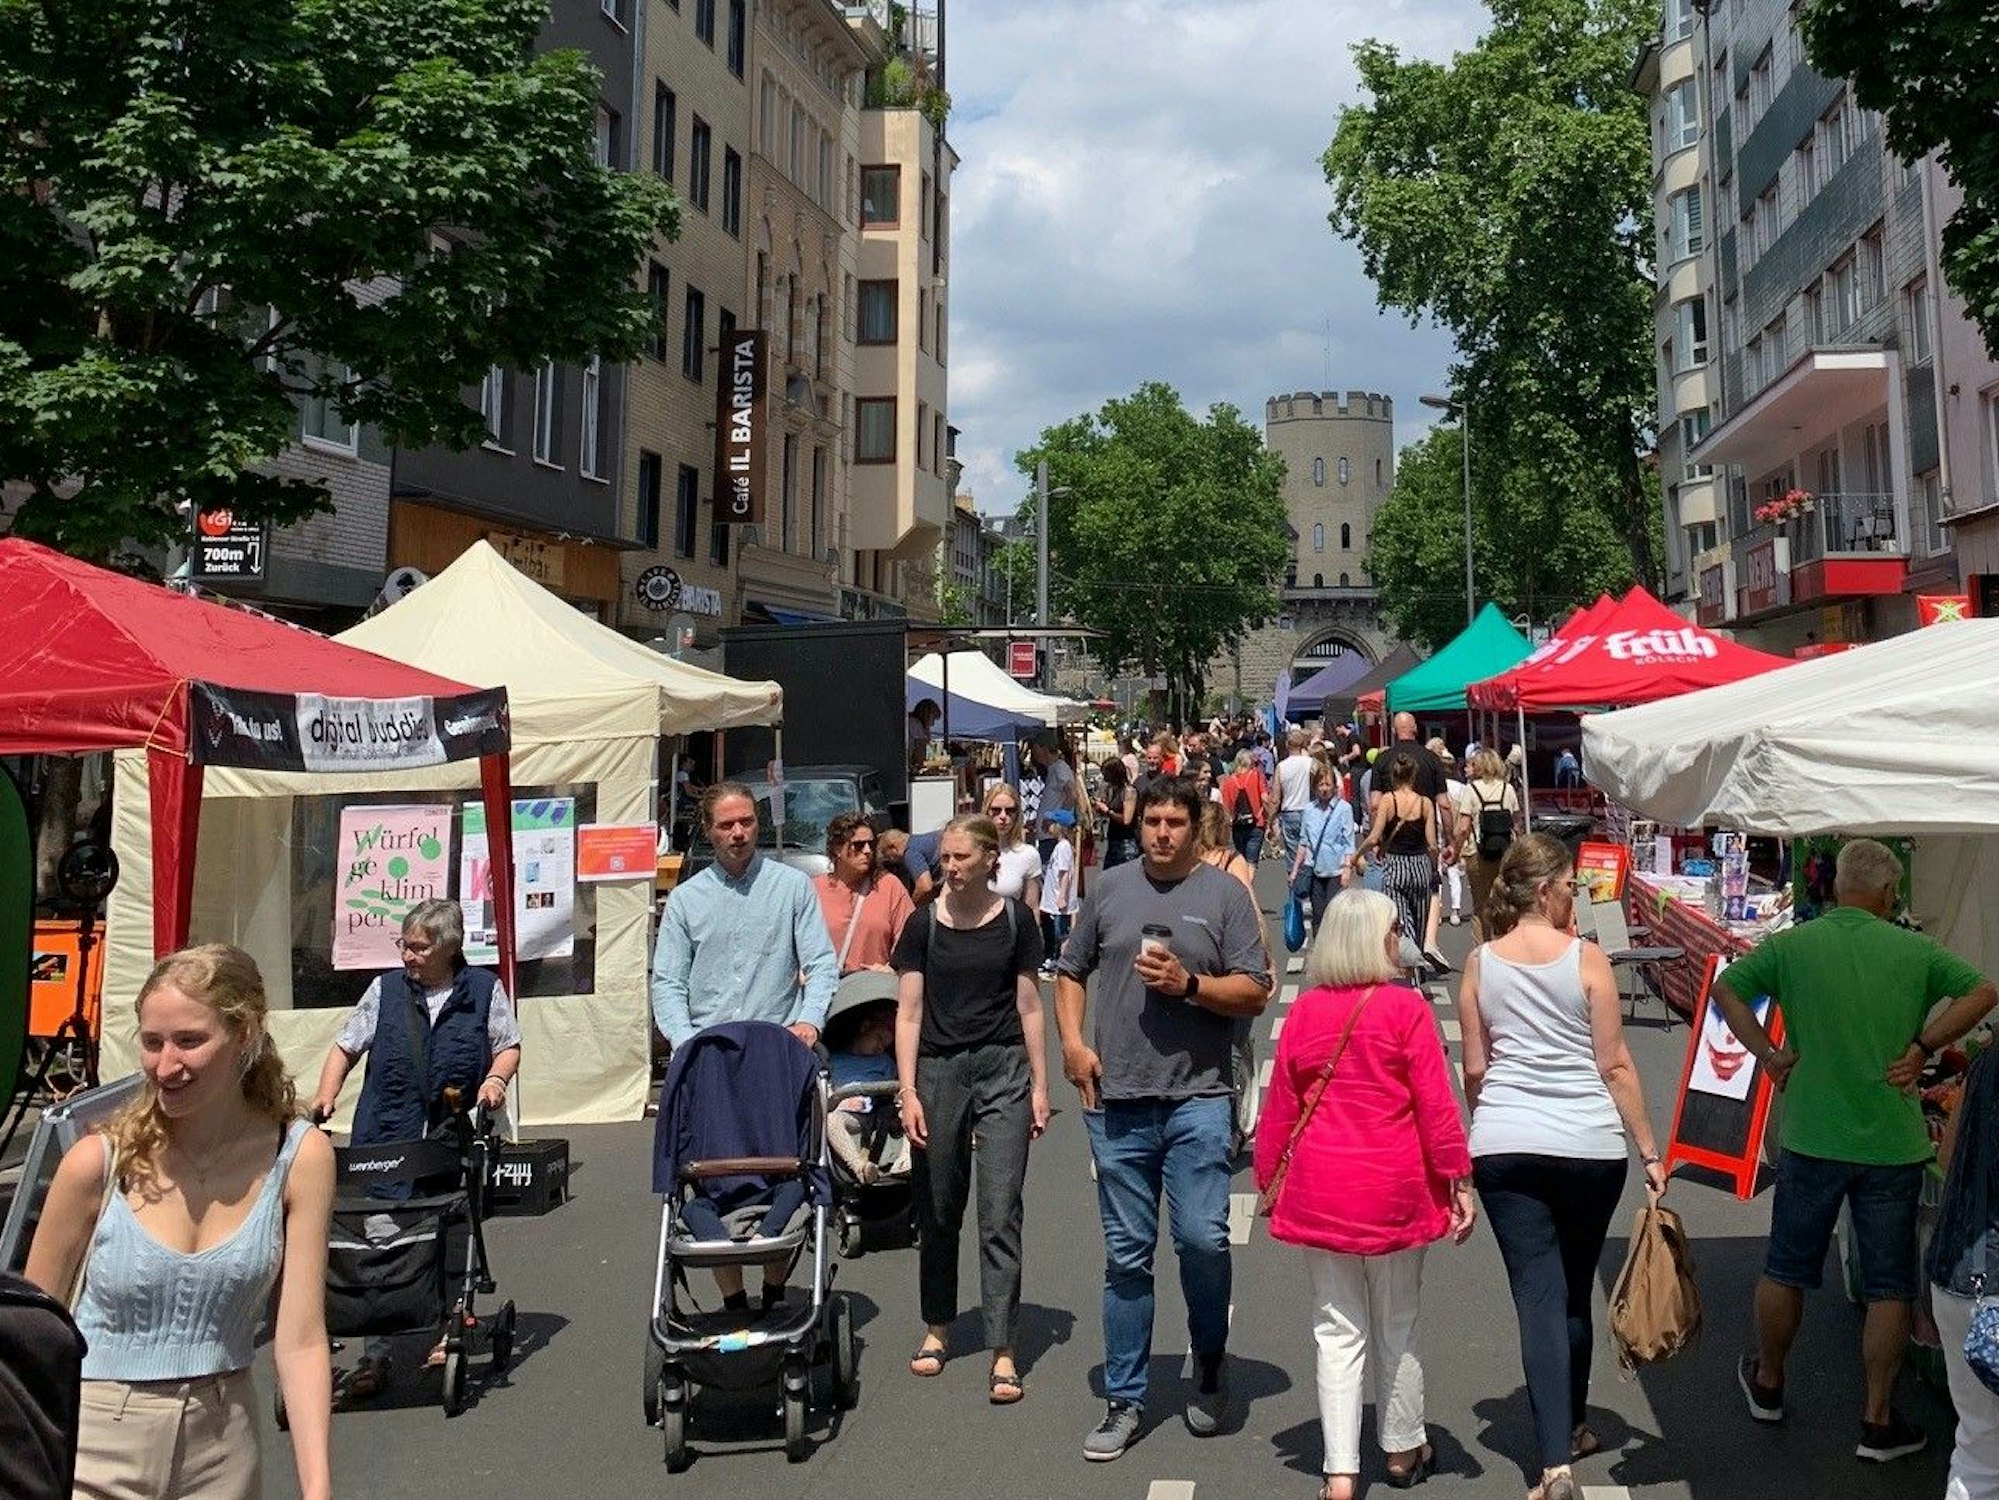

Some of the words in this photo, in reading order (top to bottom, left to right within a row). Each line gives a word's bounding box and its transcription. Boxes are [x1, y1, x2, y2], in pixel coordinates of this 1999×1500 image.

[731, 339, 754, 443] BARISTA
[731, 449, 750, 471] IL
[732, 477, 750, 514] Café
[203, 548, 244, 560] 700m
[204, 562, 240, 573] Zurück
[1634, 654, 1699, 666] KÖLSCH
[311, 710, 363, 751] digital
[366, 711, 429, 743] buddies
[350, 859, 377, 882] ge
[380, 878, 435, 901] klim
[347, 912, 388, 935] per
